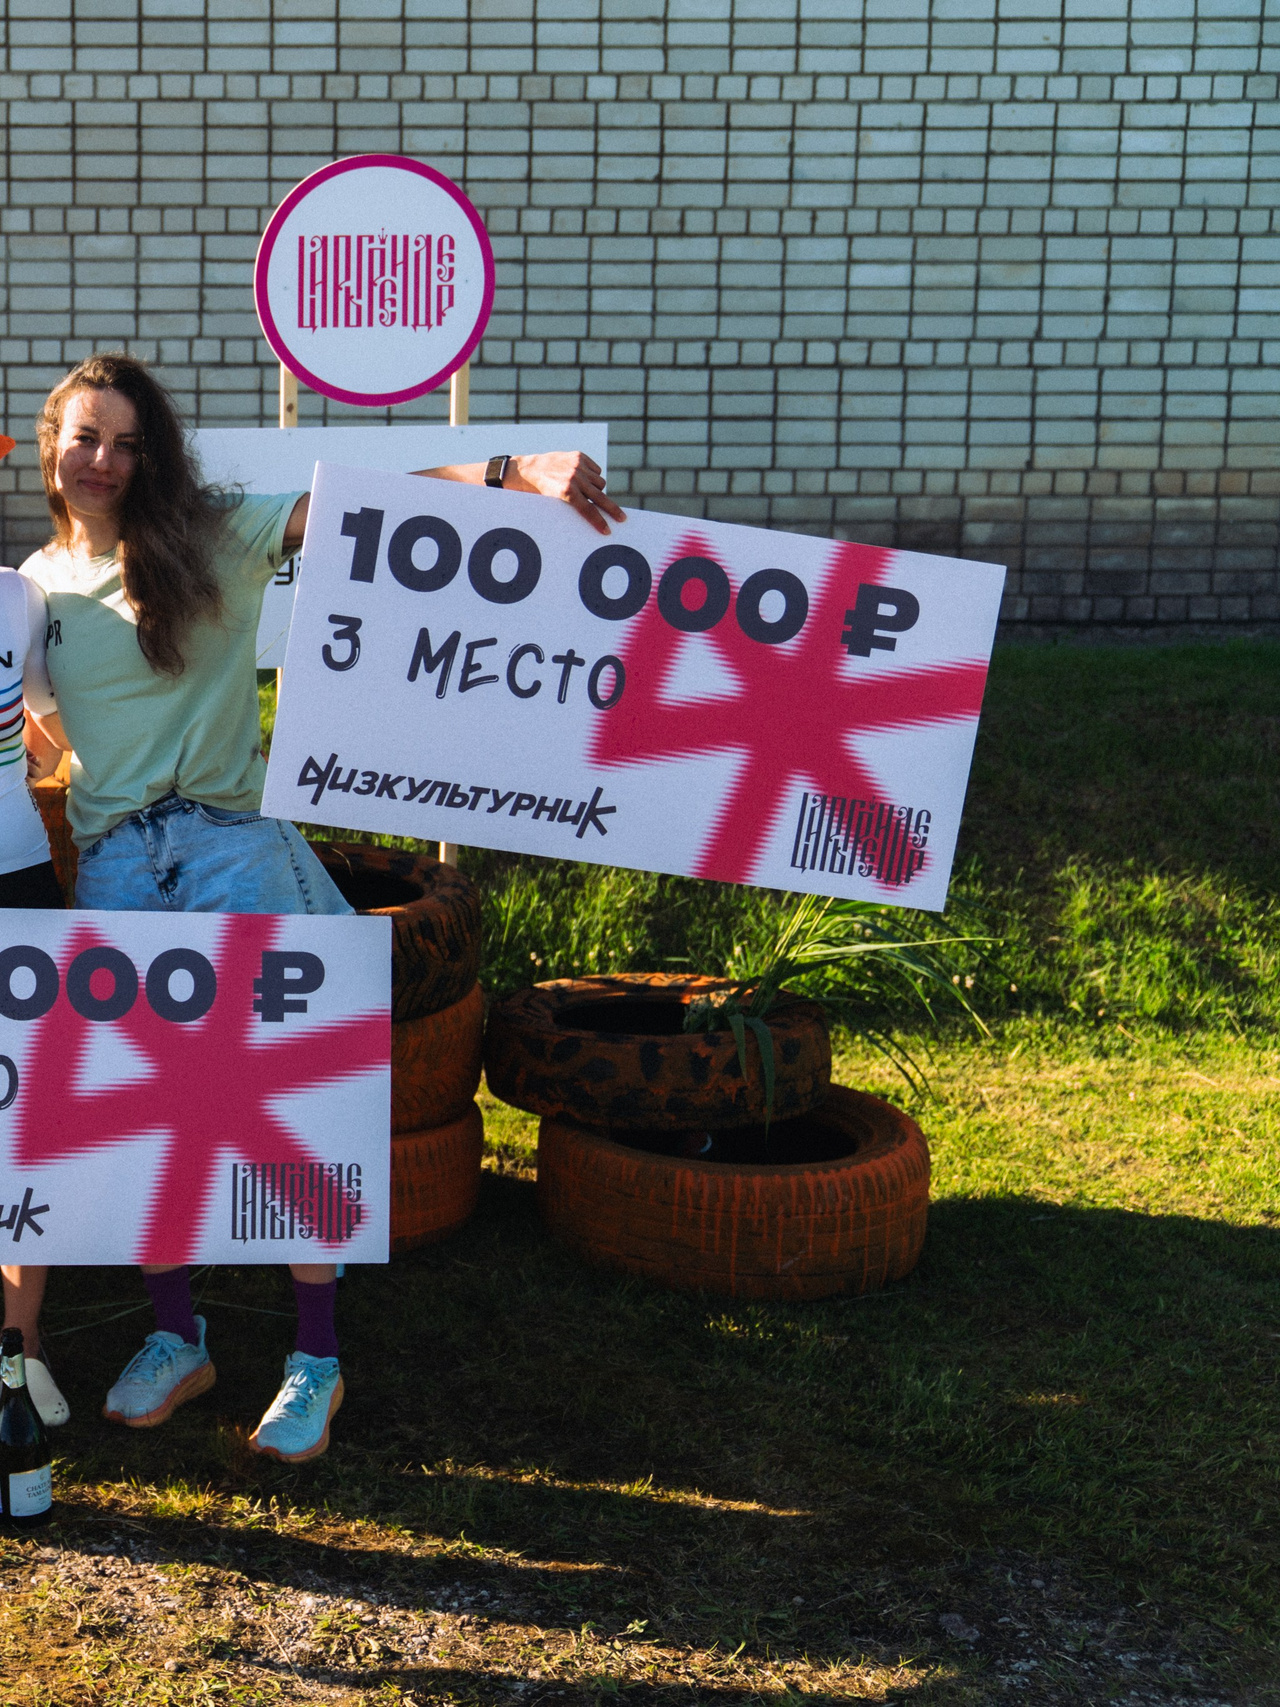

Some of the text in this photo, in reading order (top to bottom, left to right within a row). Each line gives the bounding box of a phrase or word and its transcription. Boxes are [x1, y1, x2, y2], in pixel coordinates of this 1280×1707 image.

[340, 506, 542, 605] 100
[578, 543, 809, 645] 000
[321, 614, 626, 711] 3 МЕСТО
